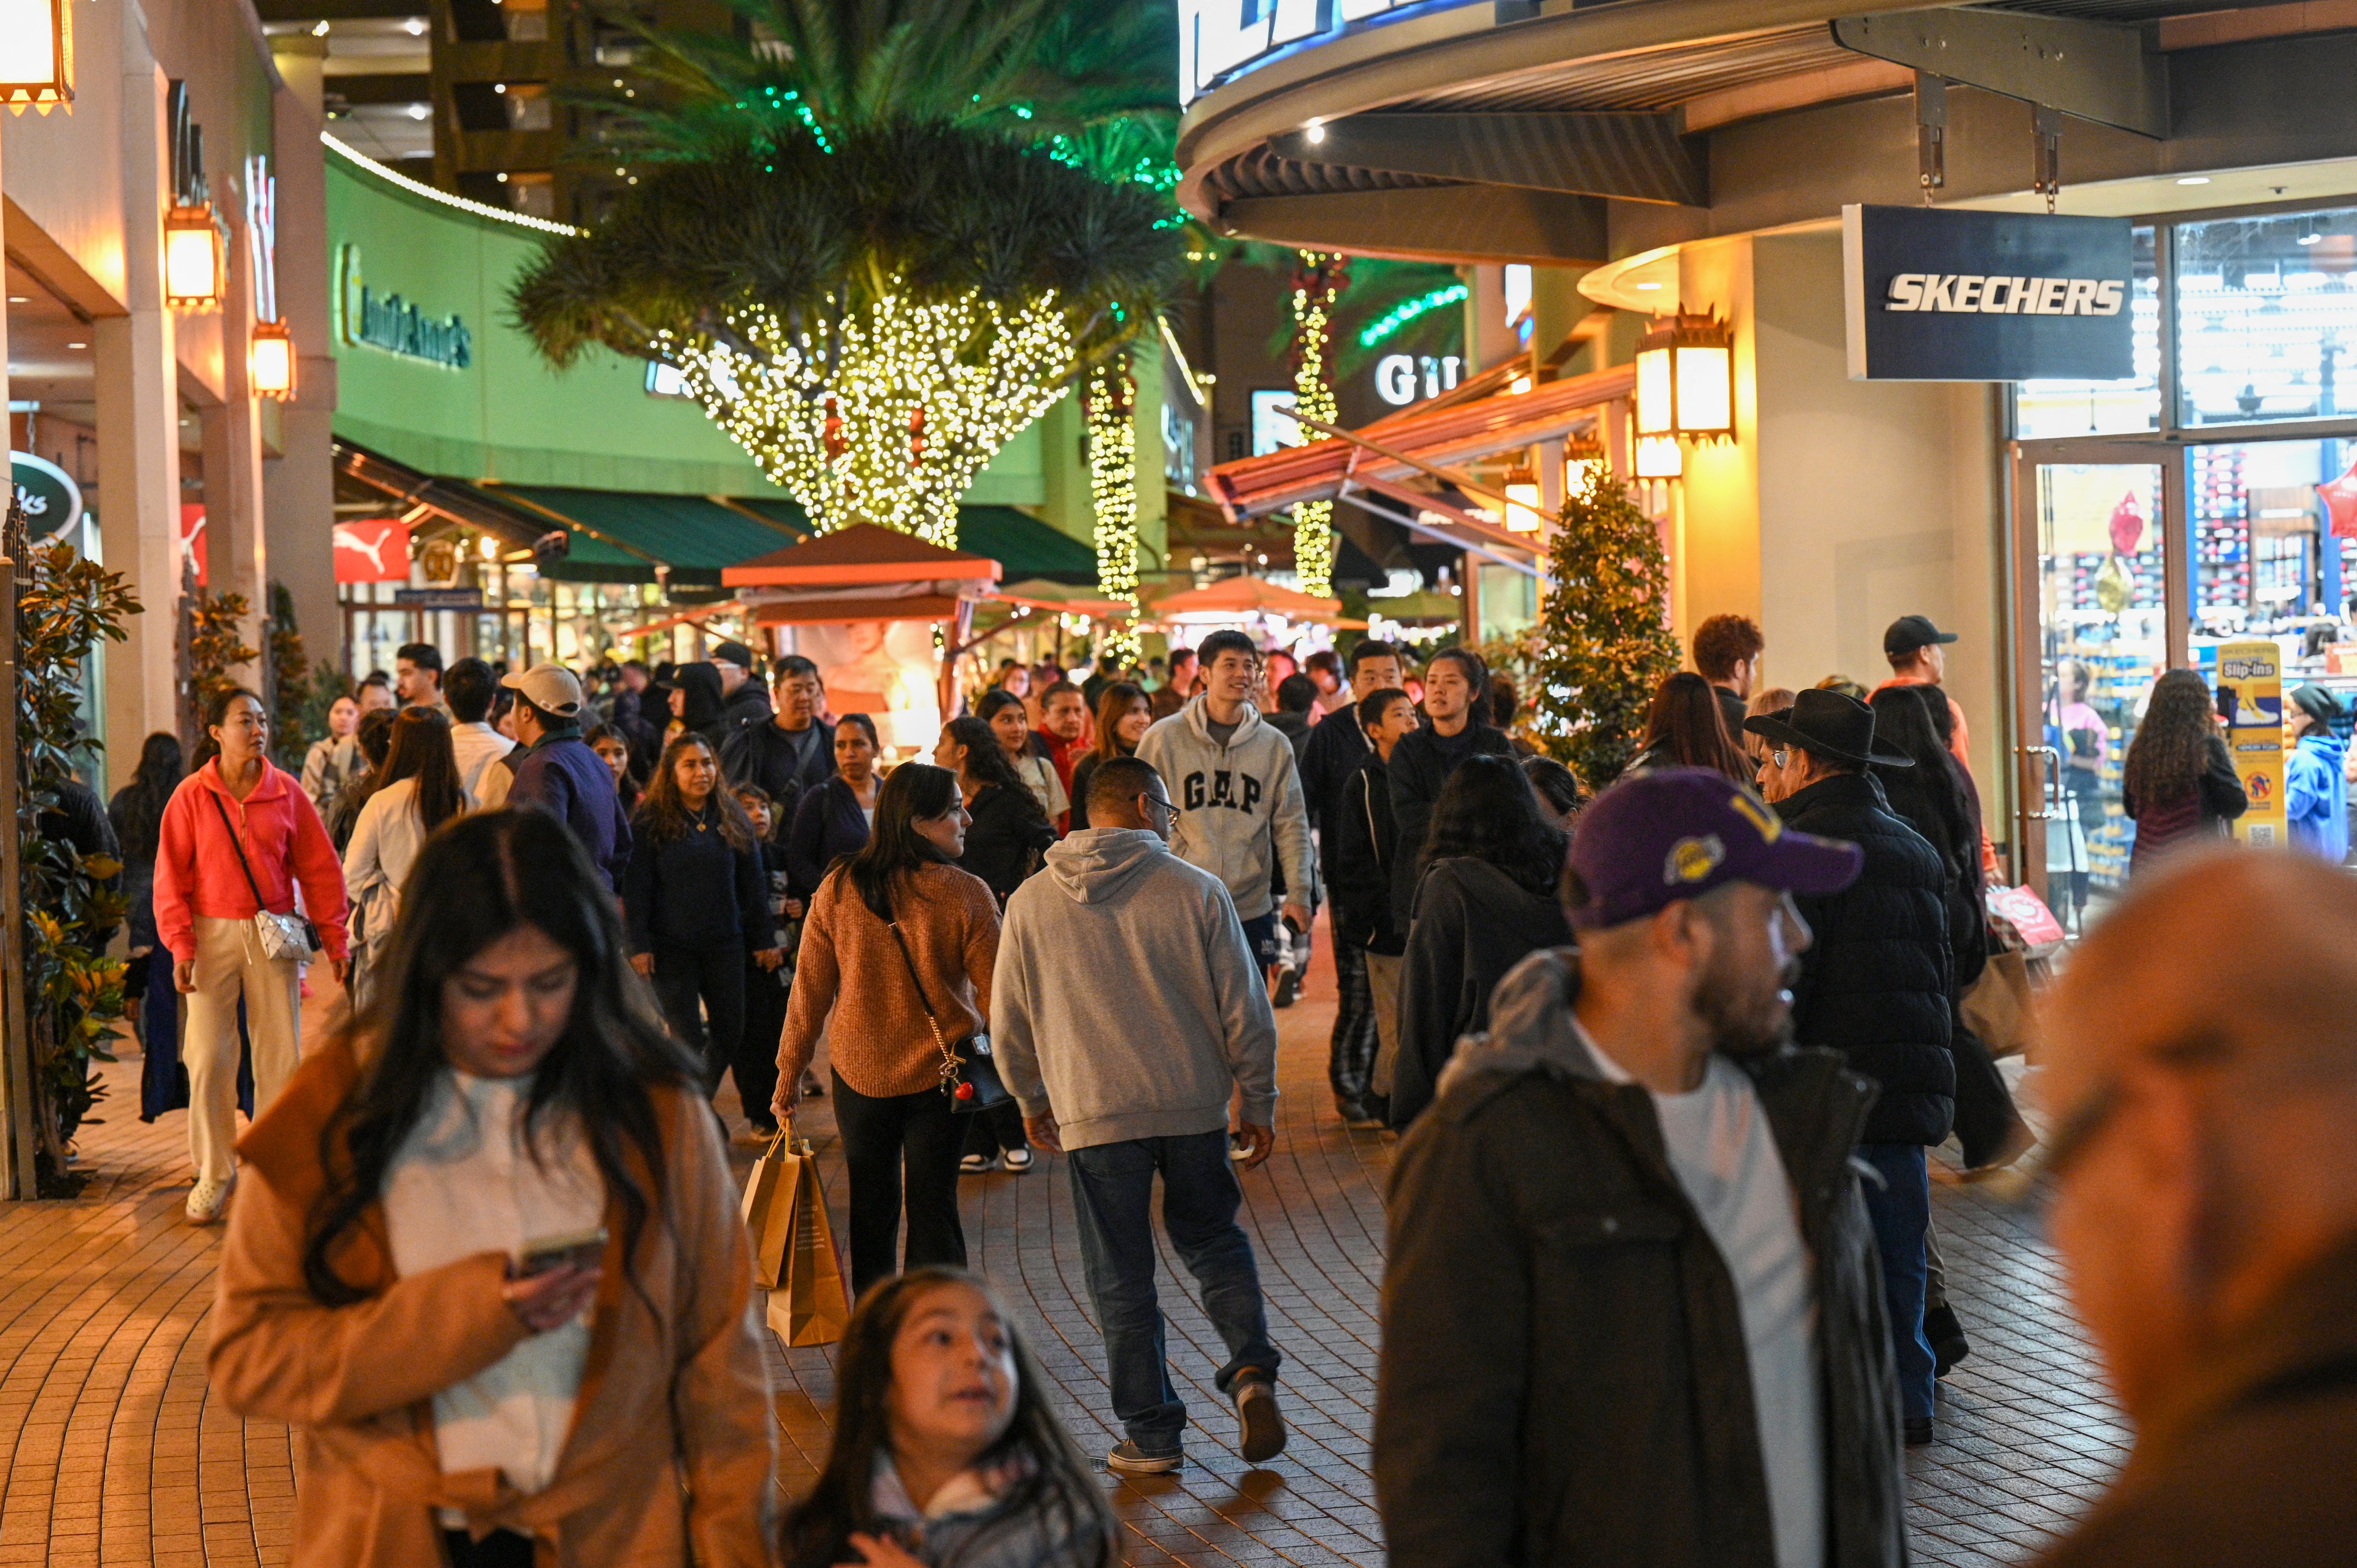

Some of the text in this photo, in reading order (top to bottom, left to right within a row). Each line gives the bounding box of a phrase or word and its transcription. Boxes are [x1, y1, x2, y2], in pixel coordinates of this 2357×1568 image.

[1885, 273, 2124, 315] SKECHERS
[2223, 661, 2274, 680] Slip-ins
[1184, 770, 1261, 815] GAP
